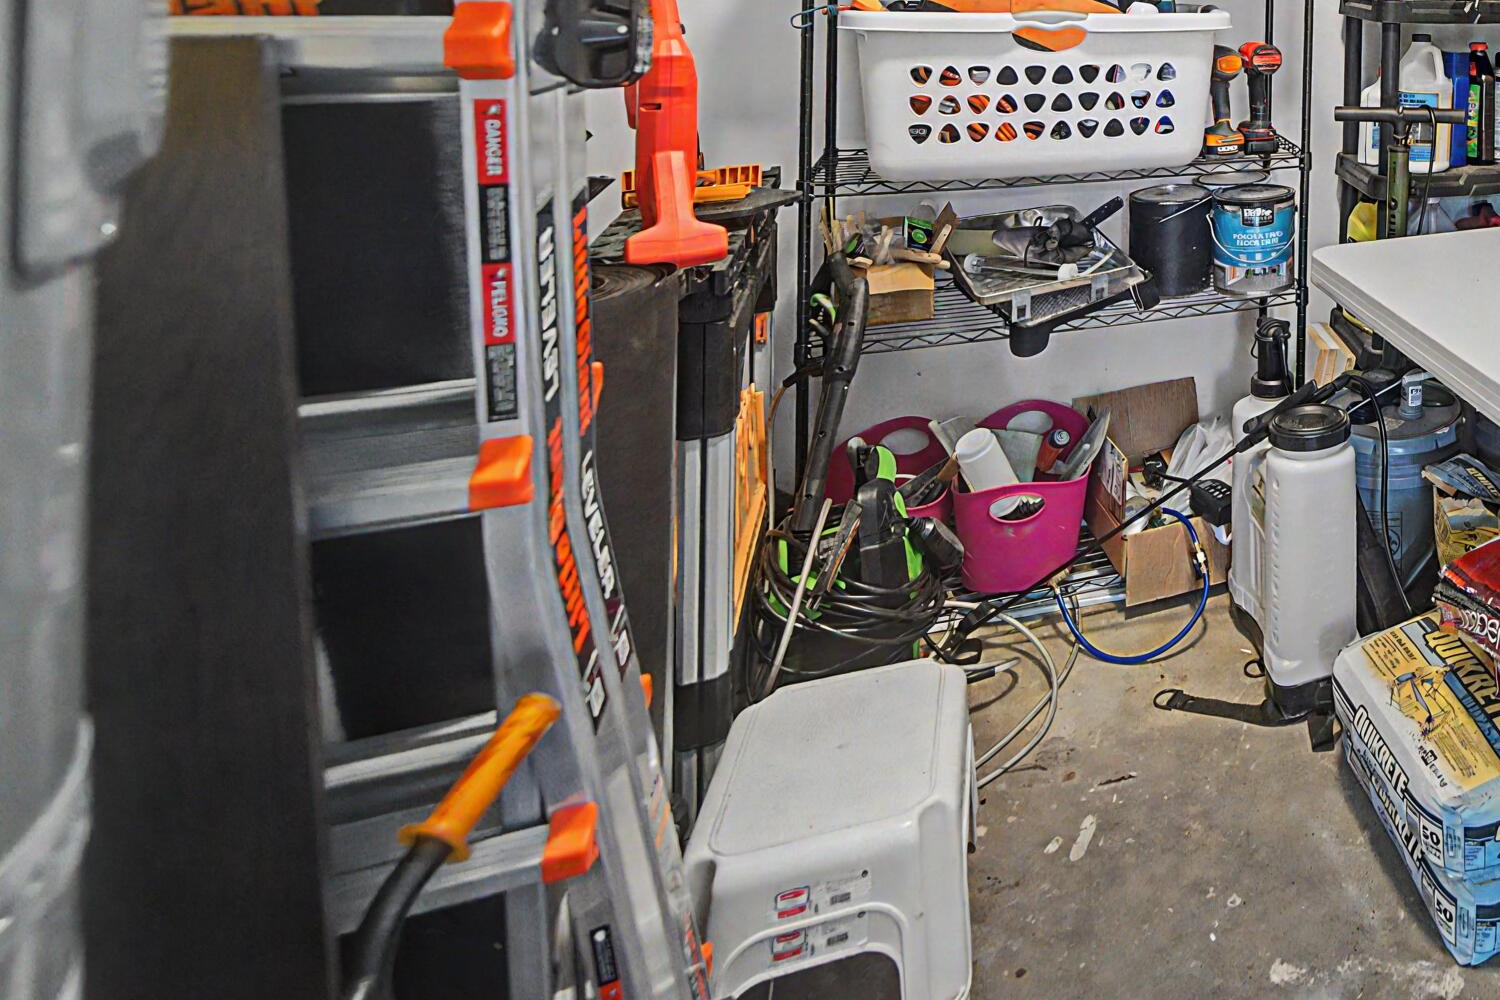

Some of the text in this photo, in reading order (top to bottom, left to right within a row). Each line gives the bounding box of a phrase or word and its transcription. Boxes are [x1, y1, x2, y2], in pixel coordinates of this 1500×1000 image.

[581, 450, 615, 600] LEVELER
[1353, 705, 1409, 799] QUIKRETE
[1420, 825, 1441, 847] 50
[1435, 896, 1454, 924] 50
